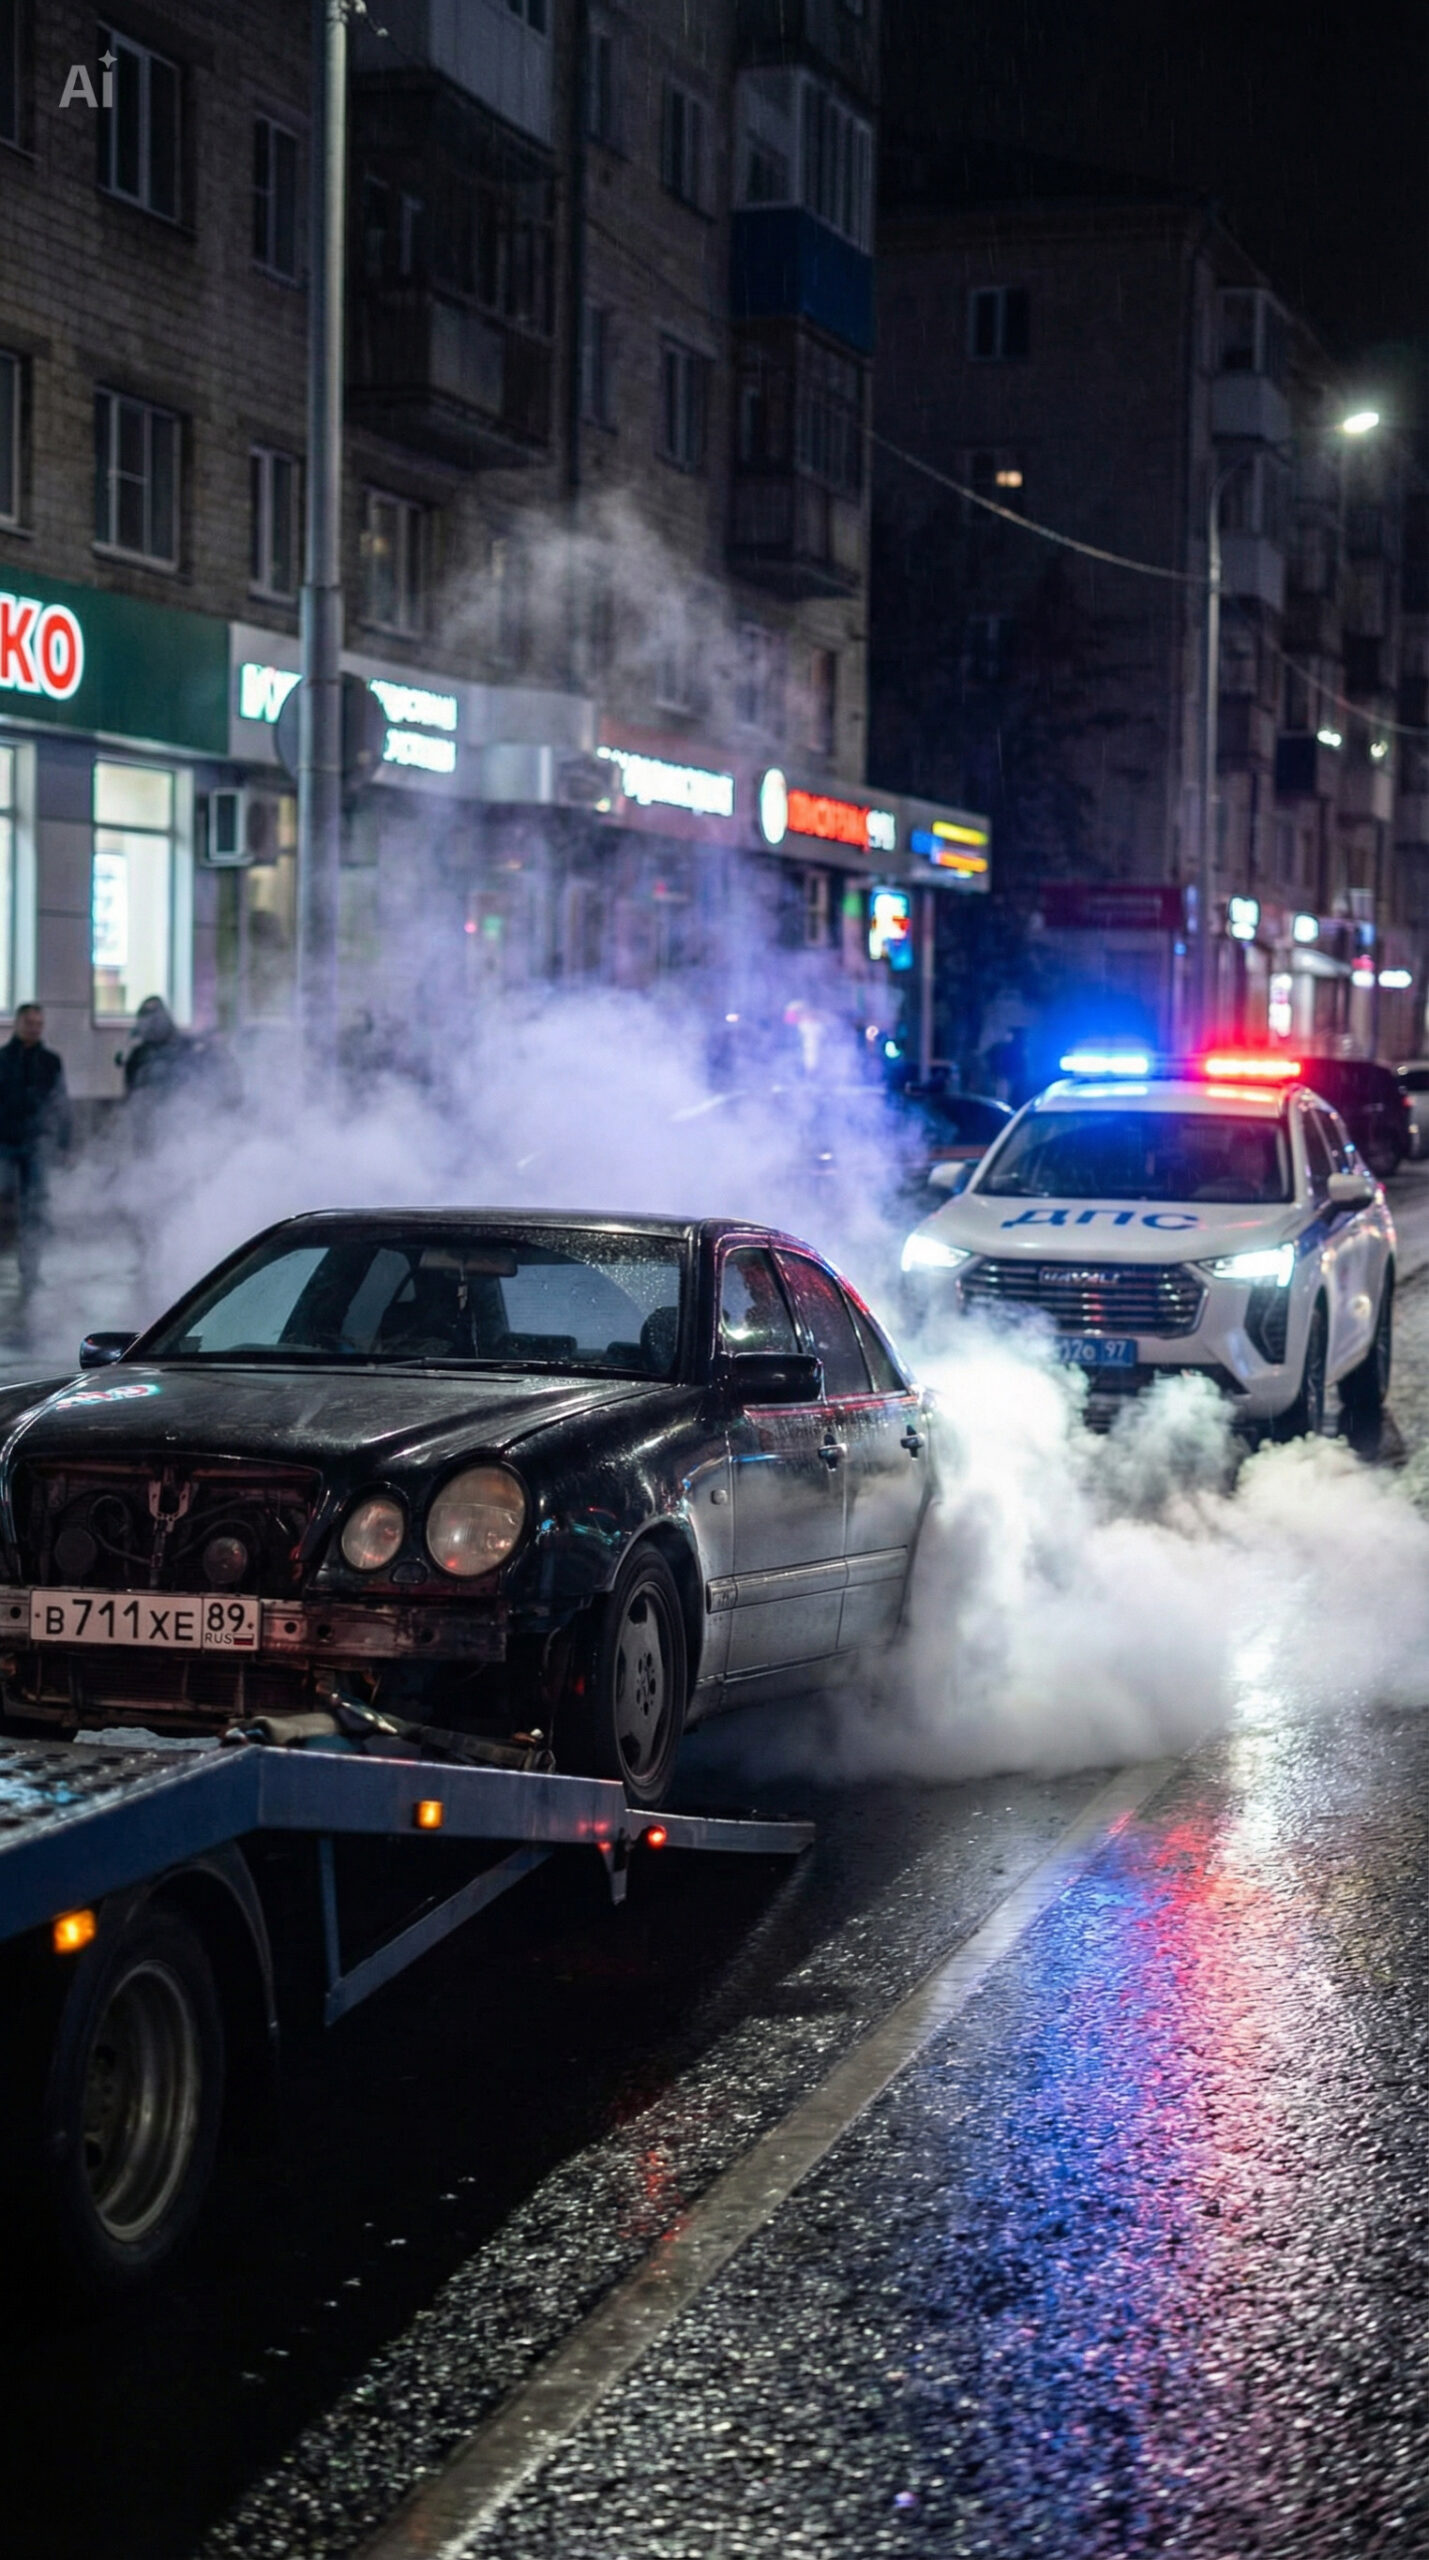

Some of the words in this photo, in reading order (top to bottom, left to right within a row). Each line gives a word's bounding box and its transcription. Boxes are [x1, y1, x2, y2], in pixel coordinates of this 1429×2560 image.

[1001, 1209, 1199, 1231] ДПС
[46, 1599, 194, 1641] В711ХЕ
[206, 1602, 245, 1632] 89
[204, 1632, 233, 1645] RUS
